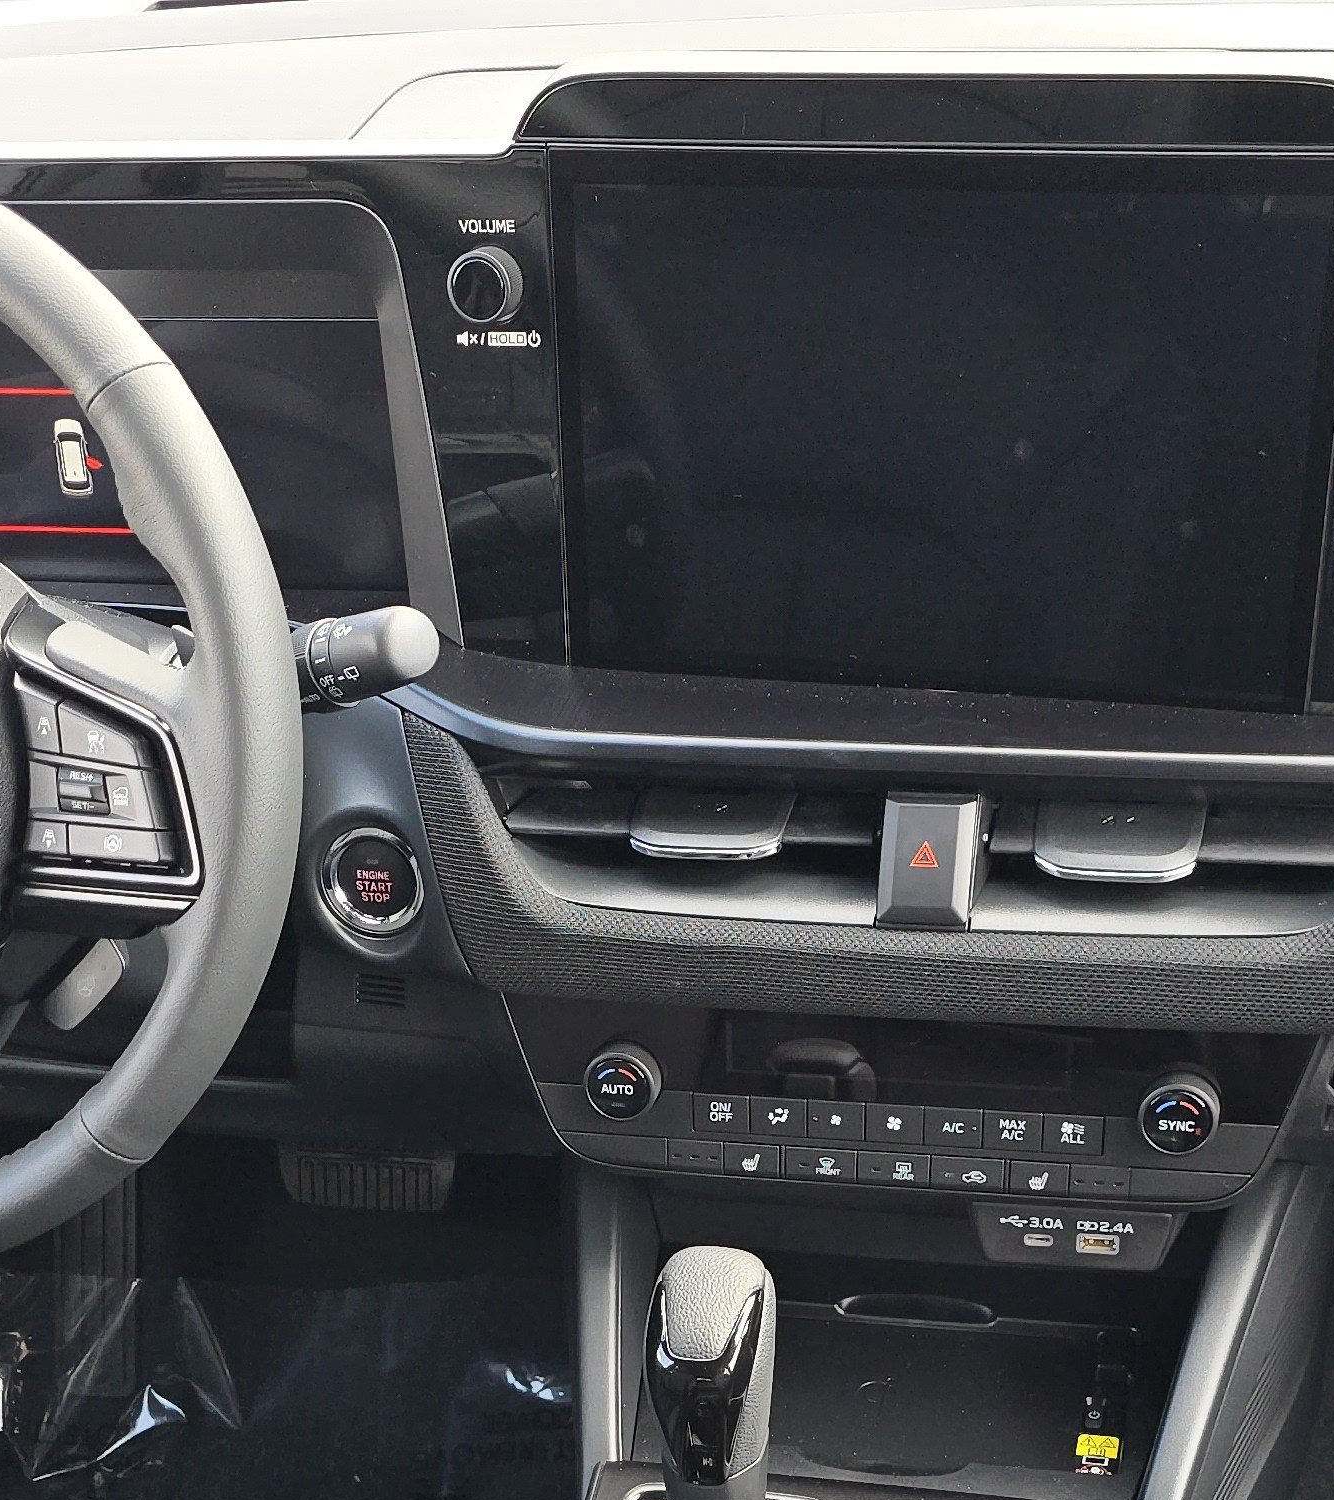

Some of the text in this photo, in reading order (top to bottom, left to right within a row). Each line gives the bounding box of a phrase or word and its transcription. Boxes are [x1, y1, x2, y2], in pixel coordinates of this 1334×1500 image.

[458, 219, 516, 234] VOLUME
[489, 332, 527, 345] HOLD
[319, 674, 335, 688] OFF
[356, 869, 390, 881] ENGINE
[355, 881, 393, 892] START
[361, 891, 391, 903] STOP
[601, 1084, 634, 1096] AUTO
[710, 1102, 733, 1112] ON/
[709, 1111, 733, 1122] OFF
[941, 1122, 965, 1134] A/C
[999, 1118, 1026, 1131] MAX
[1158, 1120, 1196, 1133] SYNC
[1001, 1129, 1024, 1141] A/C
[1061, 1134, 1085, 1145] ALL
[816, 1167, 841, 1177] FRONT
[1028, 1217, 1064, 1230] 3.0A
[1099, 1221, 1134, 1234] 2.4A
